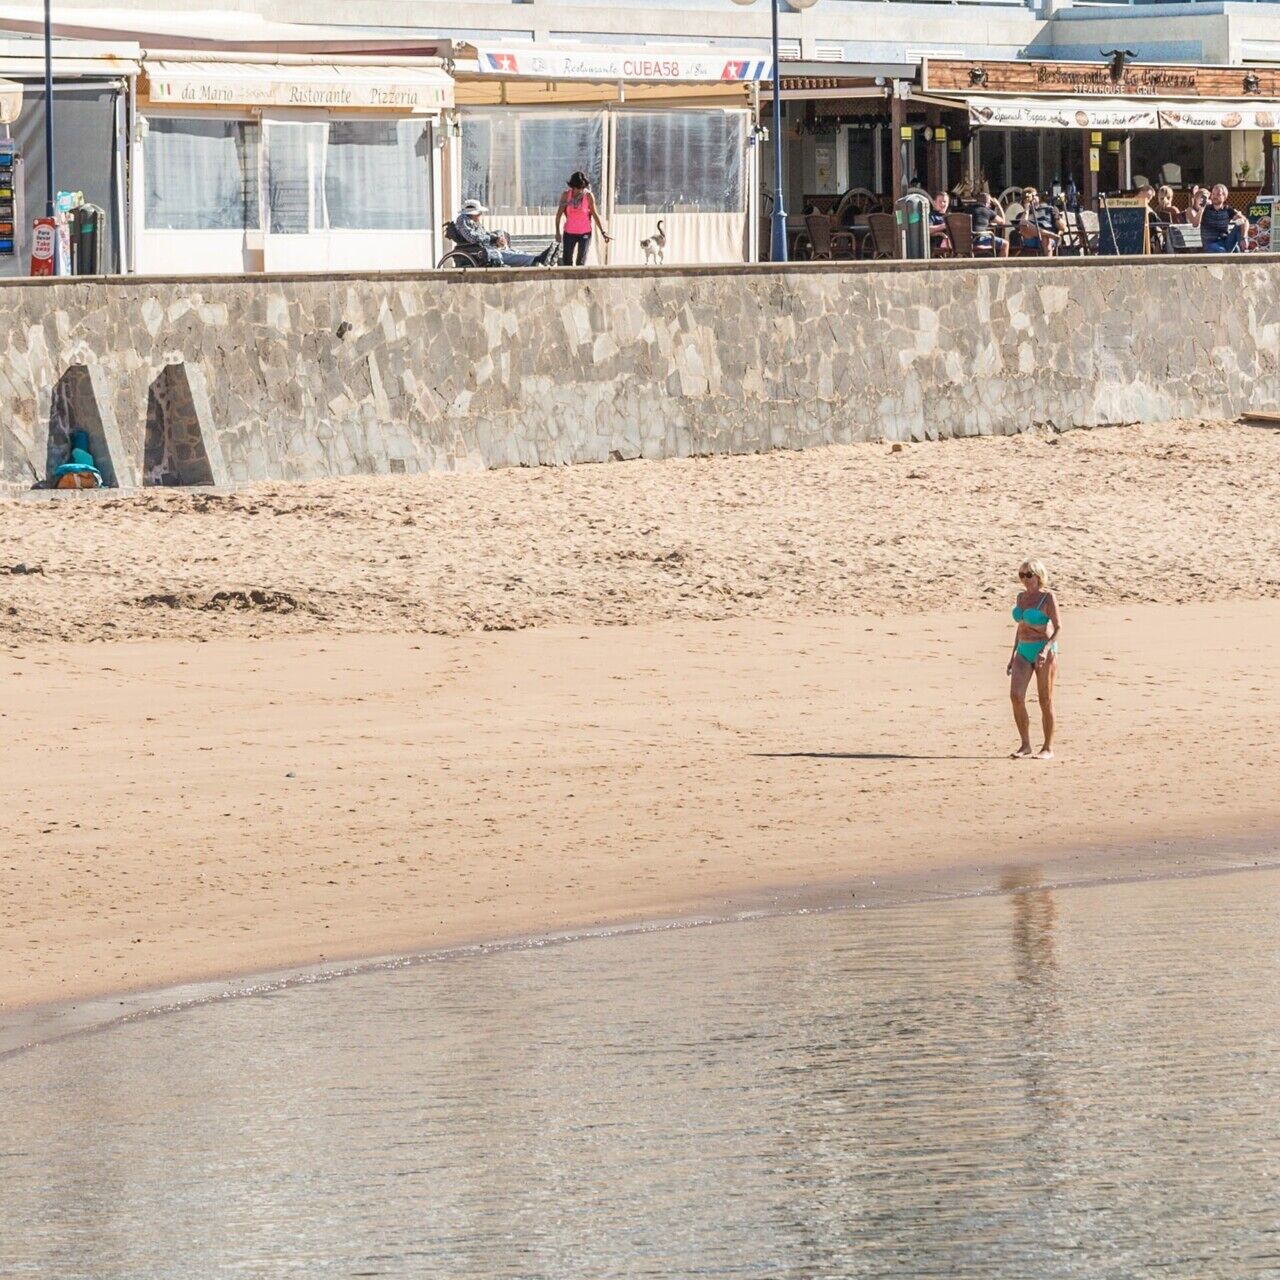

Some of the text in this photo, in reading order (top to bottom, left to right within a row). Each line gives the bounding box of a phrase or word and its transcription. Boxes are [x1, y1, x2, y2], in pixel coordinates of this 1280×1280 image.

[623, 60, 680, 77] CUBA58
[181, 83, 196, 100] da
[199, 84, 234, 101] Mario
[289, 85, 352, 104] Ristorante
[369, 87, 418, 105] Pizzeria
[1073, 84, 1160, 96] STEAKHOUSE GRILL
[1181, 114, 1218, 126] Pizzeria
